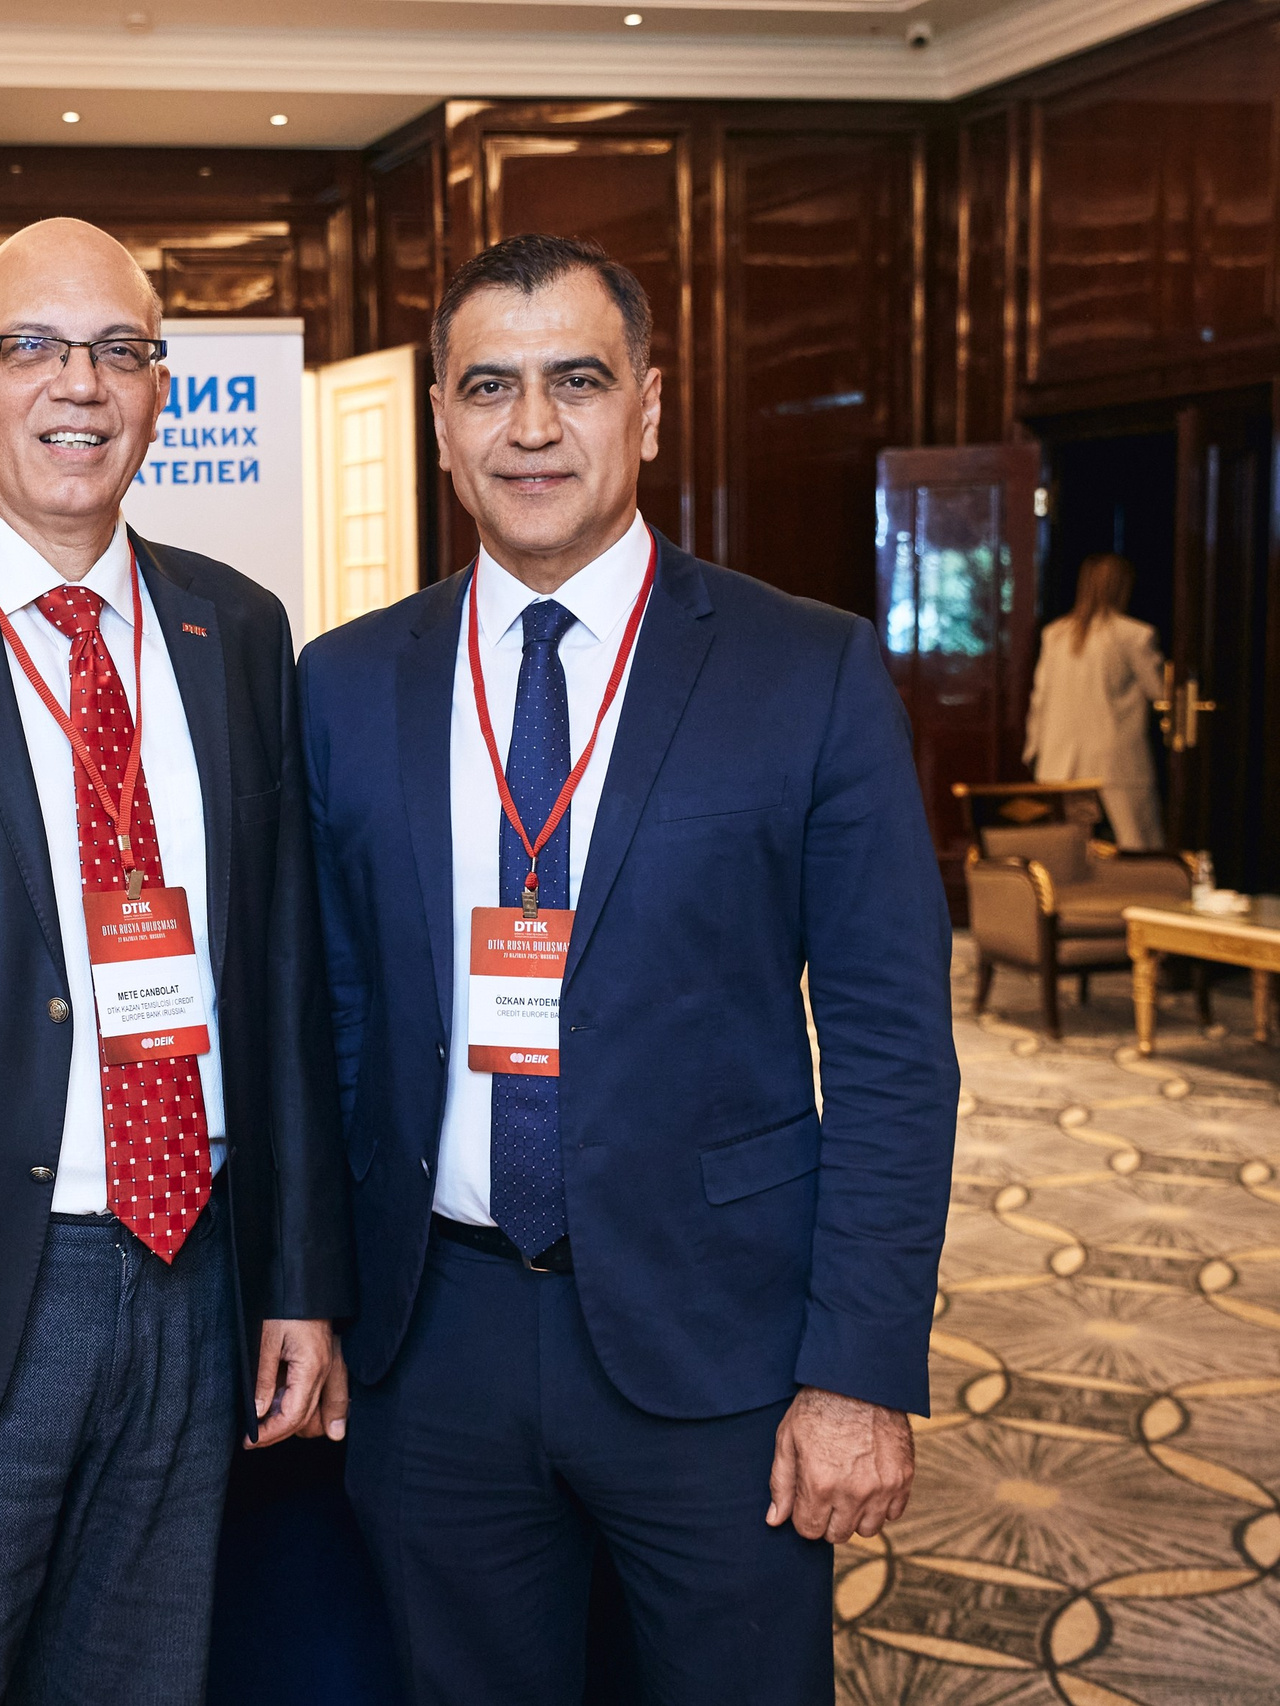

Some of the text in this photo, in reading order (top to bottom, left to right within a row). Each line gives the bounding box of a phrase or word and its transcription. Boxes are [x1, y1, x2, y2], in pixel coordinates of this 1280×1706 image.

[119, 922, 140, 935] RUSYA
[507, 940, 530, 951] RUSYA
[533, 941, 569, 953] BULUŞMA
[117, 984, 179, 1001] METE CANBOLAT
[495, 994, 560, 1007] ÖZKAN AYDEMİ
[121, 1004, 140, 1013] KAZAN
[522, 1010, 549, 1018] EUROPE
[121, 1012, 145, 1022] EUROPE
[146, 1010, 161, 1019] BANK
